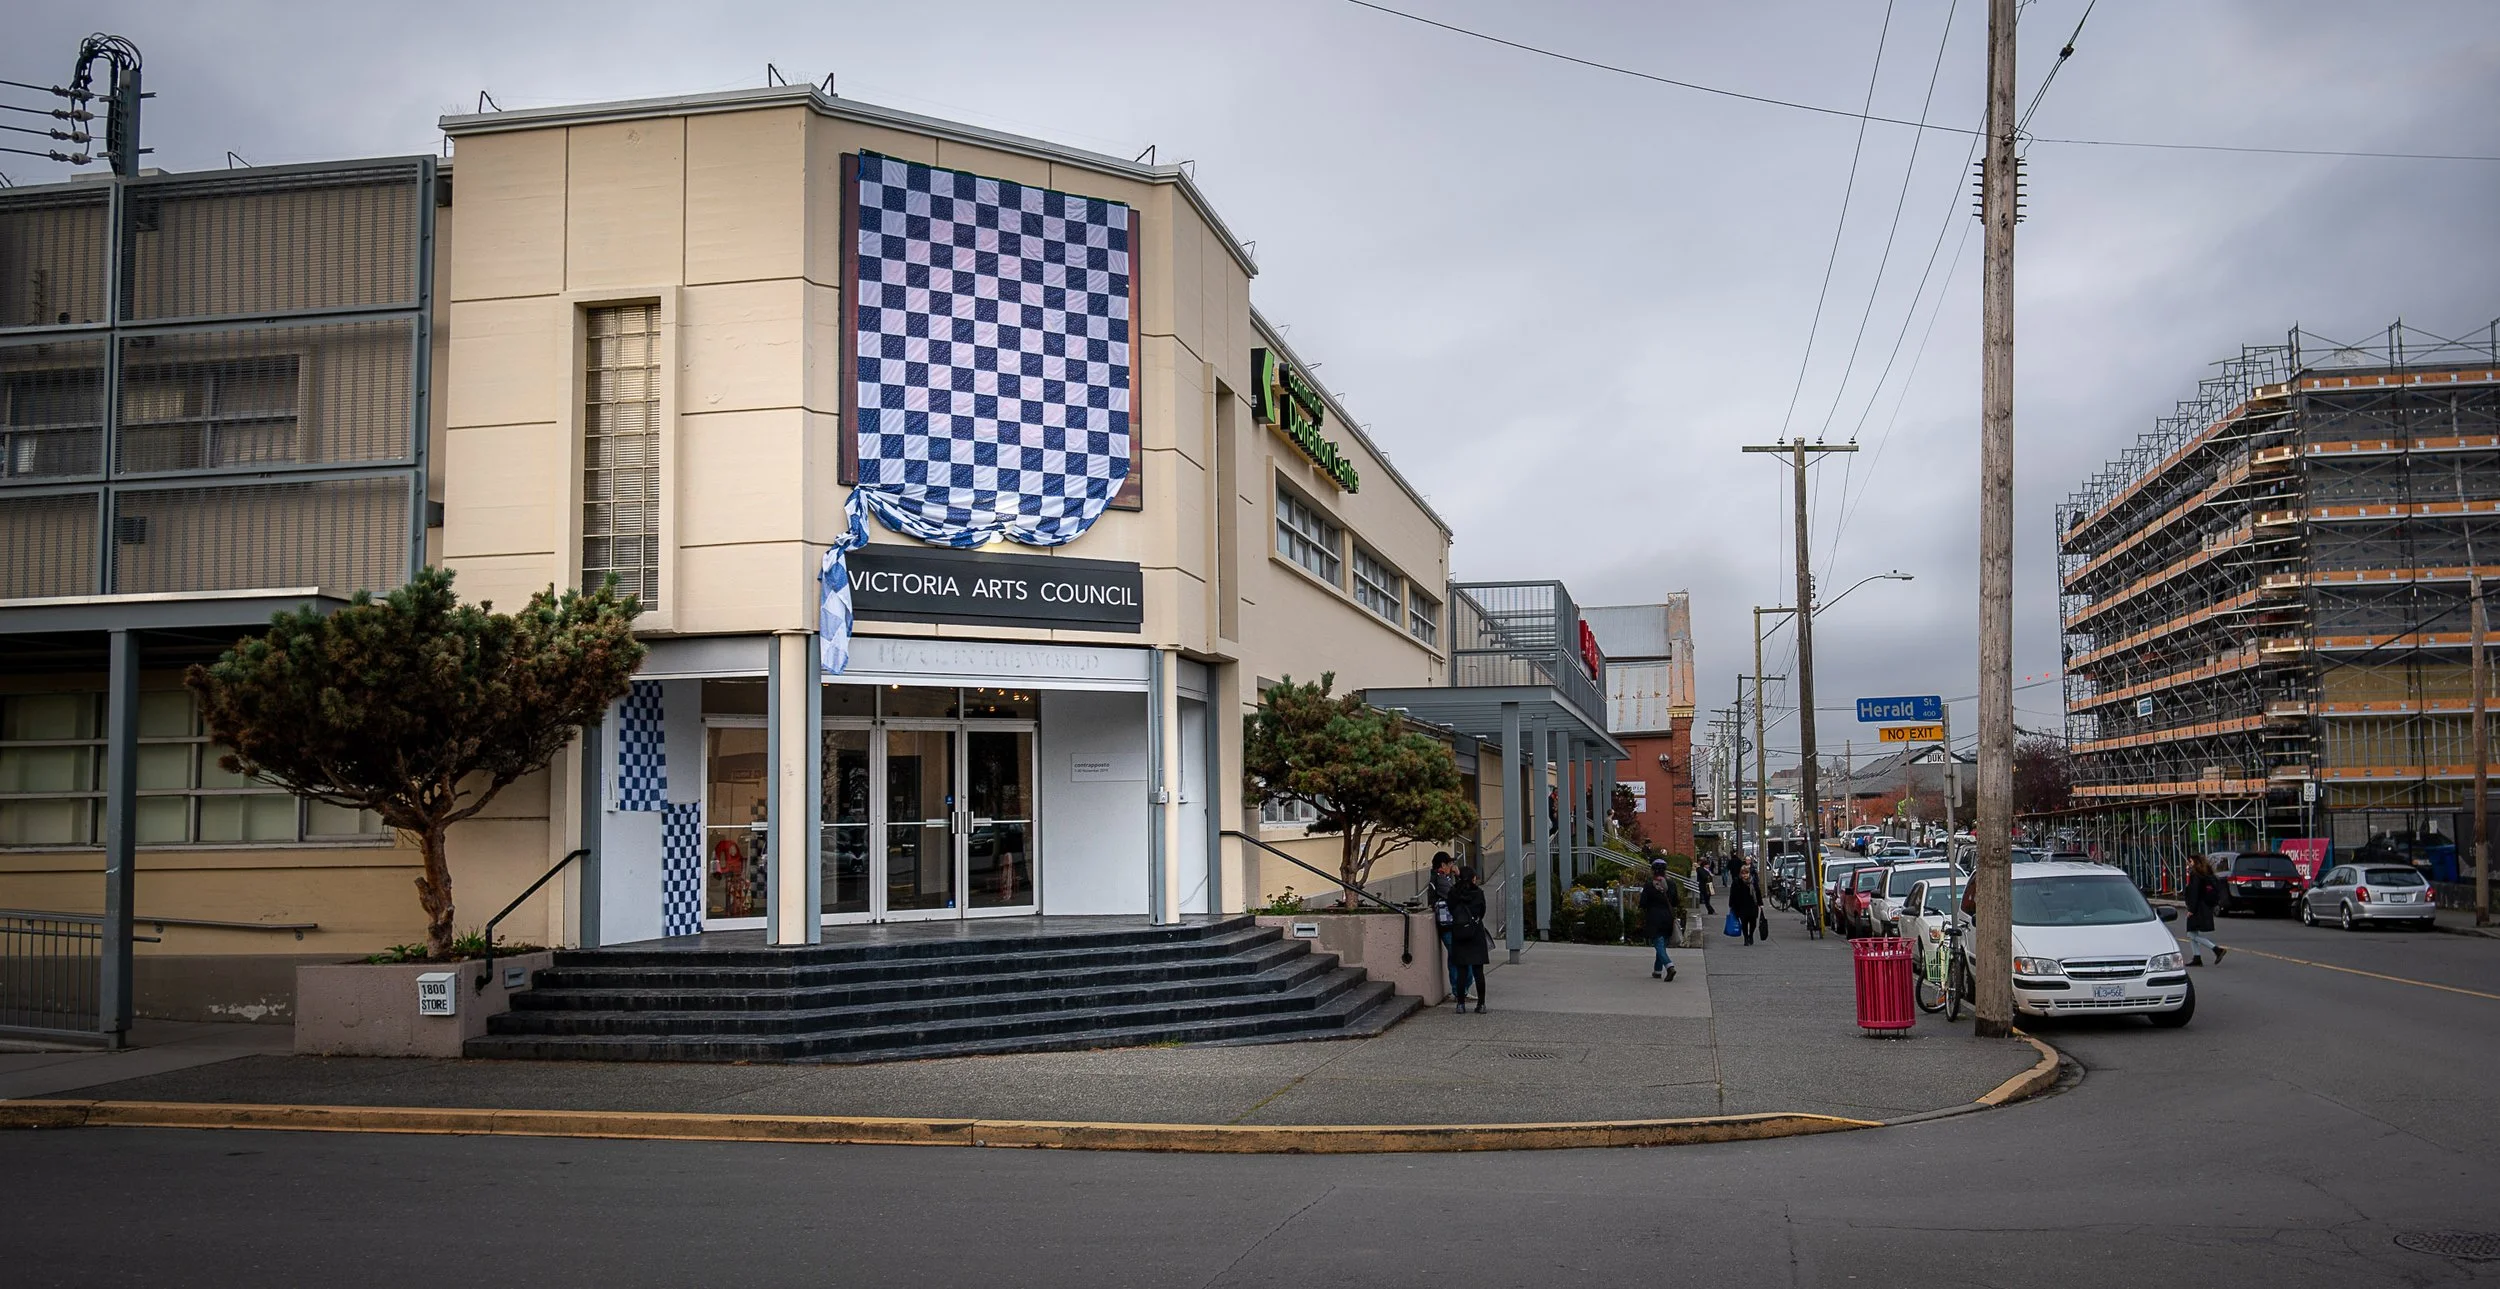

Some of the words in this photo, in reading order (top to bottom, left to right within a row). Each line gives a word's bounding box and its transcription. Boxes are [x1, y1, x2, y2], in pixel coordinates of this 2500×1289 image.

[1284, 394, 1331, 469] Donation
[1332, 441, 1360, 493] Centre
[848, 570, 960, 597] VICTORIA
[972, 578, 1028, 601] ARTS
[1040, 582, 1138, 607] COUNCIL
[1026, 652, 1101, 671] WORLD
[1860, 701, 1914, 718] Herald
[1923, 697, 1935, 707] St.
[1887, 728, 1905, 740] NO
[1909, 727, 1934, 739] EXIT
[421, 984, 446, 995] 1800
[421, 999, 448, 1010] STORE
